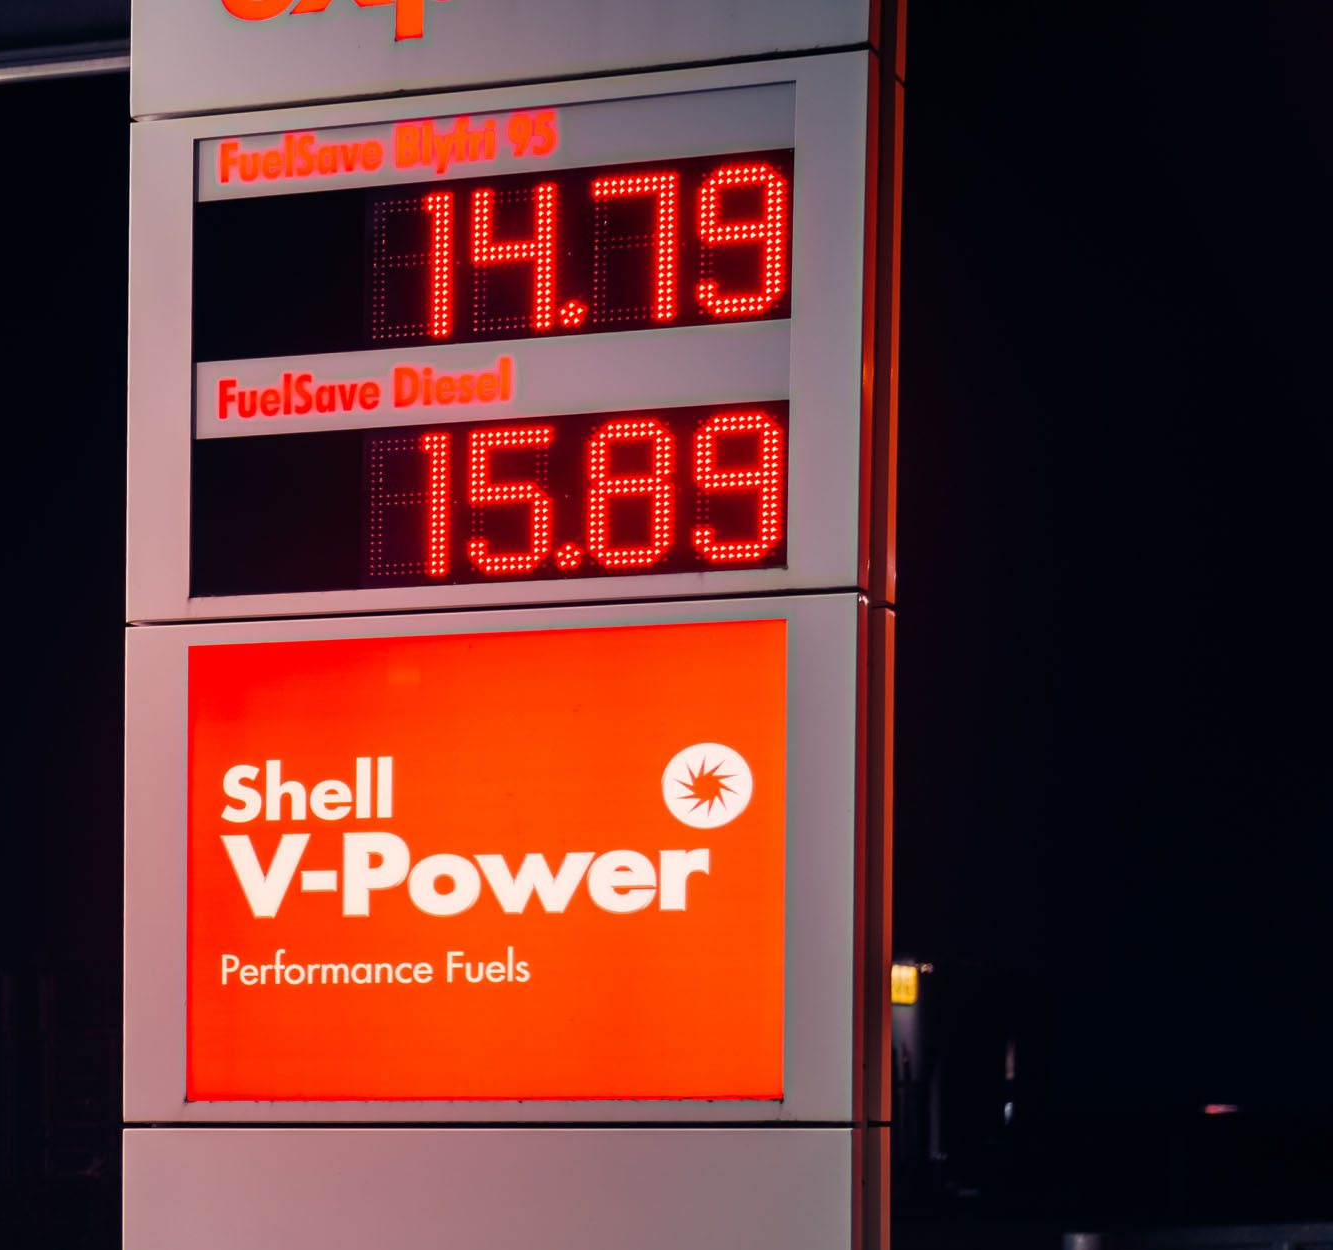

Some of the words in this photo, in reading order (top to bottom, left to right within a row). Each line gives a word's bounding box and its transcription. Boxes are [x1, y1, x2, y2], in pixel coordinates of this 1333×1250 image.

[219, 133, 384, 184] FuelSave
[395, 115, 496, 175] Blyfri
[507, 110, 558, 158] 95
[424, 163, 789, 338] 14.79
[218, 373, 381, 420] FuelSave
[393, 356, 512, 408] Diesel
[420, 412, 783, 577] 15.89
[220, 755, 394, 823] Shell
[219, 830, 711, 919] V-Power
[220, 949, 434, 986] Performance
[445, 946, 532, 985] Fuels
